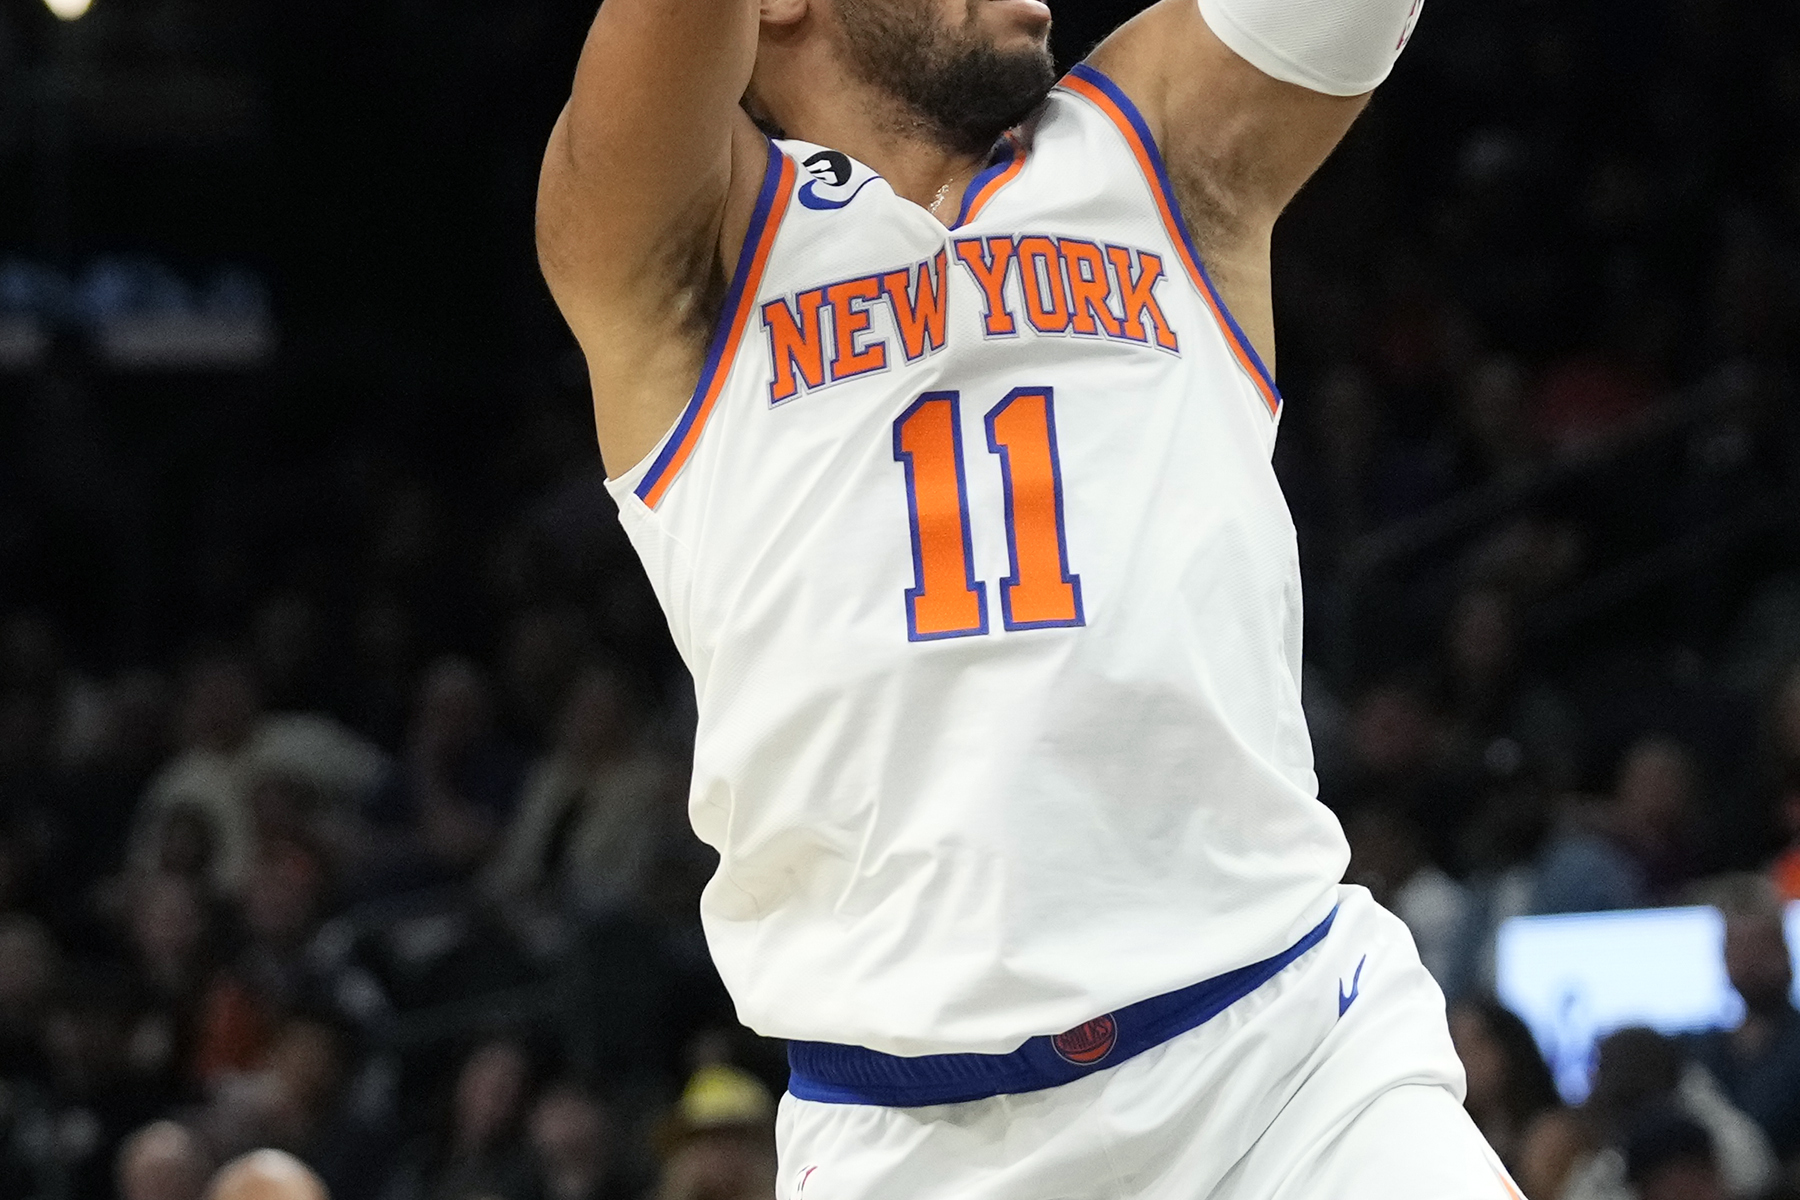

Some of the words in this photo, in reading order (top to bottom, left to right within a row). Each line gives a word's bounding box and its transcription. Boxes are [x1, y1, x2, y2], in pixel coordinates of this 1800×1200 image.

[758, 243, 950, 410] NEW
[950, 231, 1182, 358] YORK
[892, 386, 1086, 642] 11
